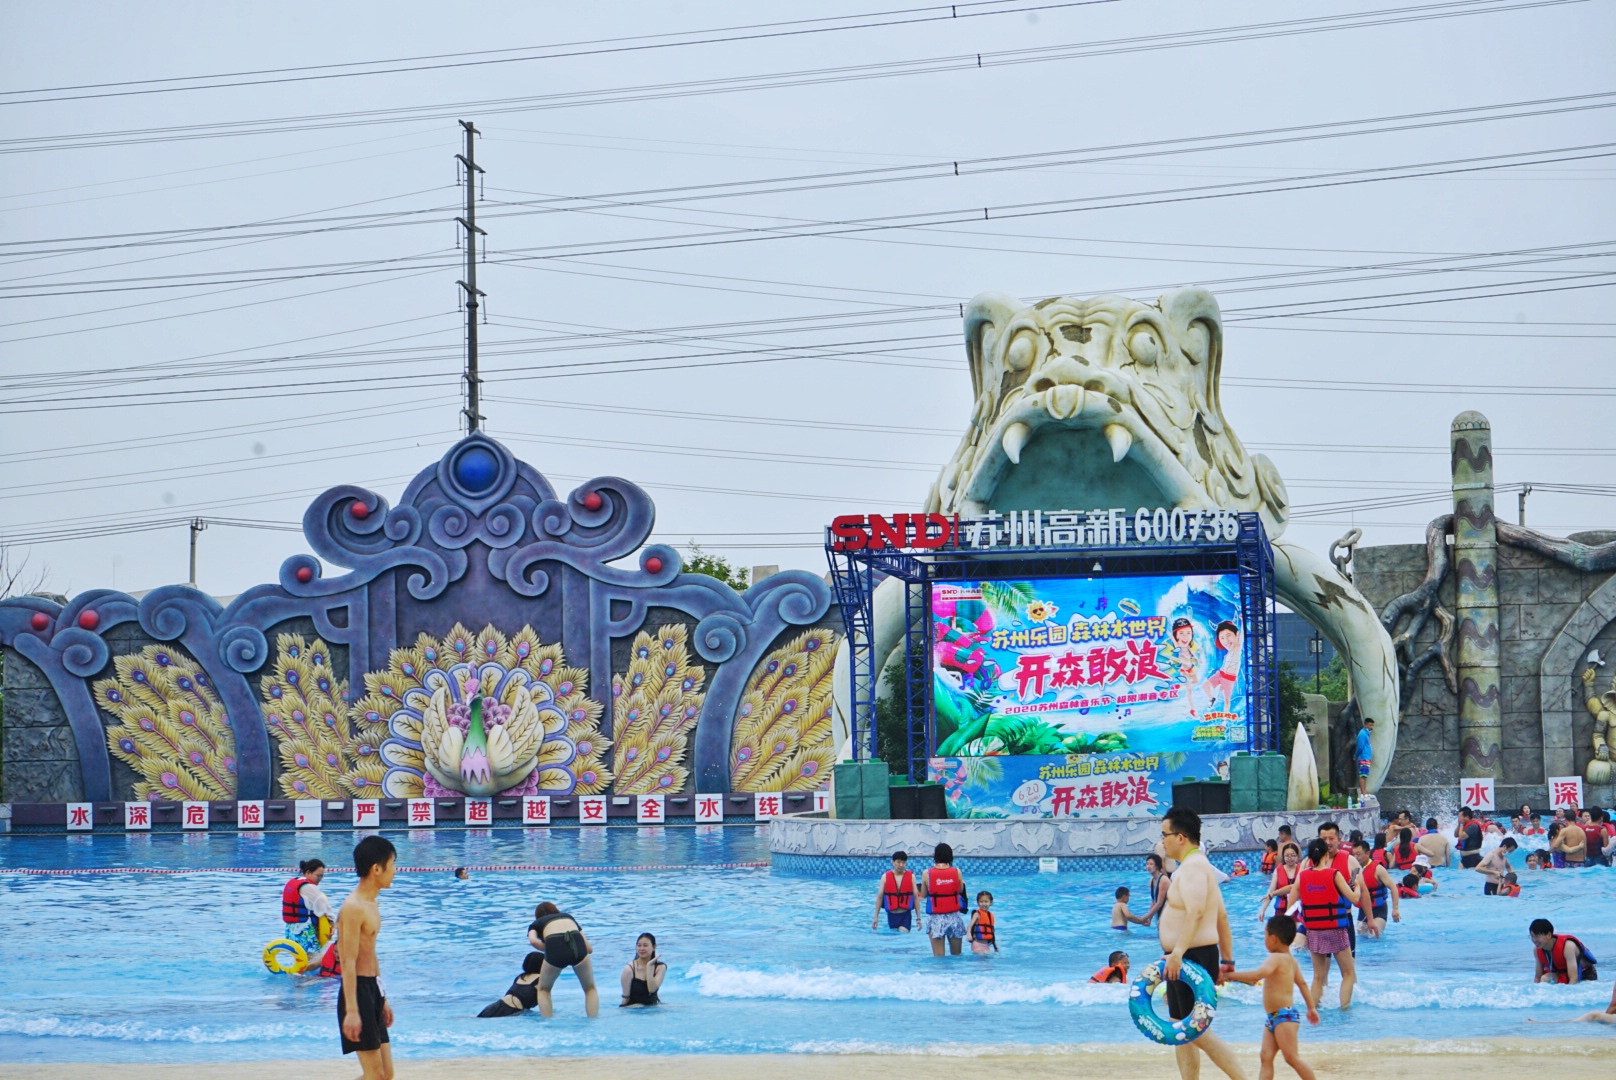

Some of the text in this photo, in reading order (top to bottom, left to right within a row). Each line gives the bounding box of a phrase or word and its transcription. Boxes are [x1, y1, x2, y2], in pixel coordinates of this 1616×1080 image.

[832, 507, 1239, 550] SND 苏州高新 600736
[991, 616, 1167, 650] 苏州乐园 森林水世界
[1014, 639, 1173, 699] 开森敢浪
[1038, 756, 1160, 780] 苏州乐园 森林水世界
[1018, 783, 1039, 801] 6.20
[1050, 775, 1158, 818] 开森敢浪
